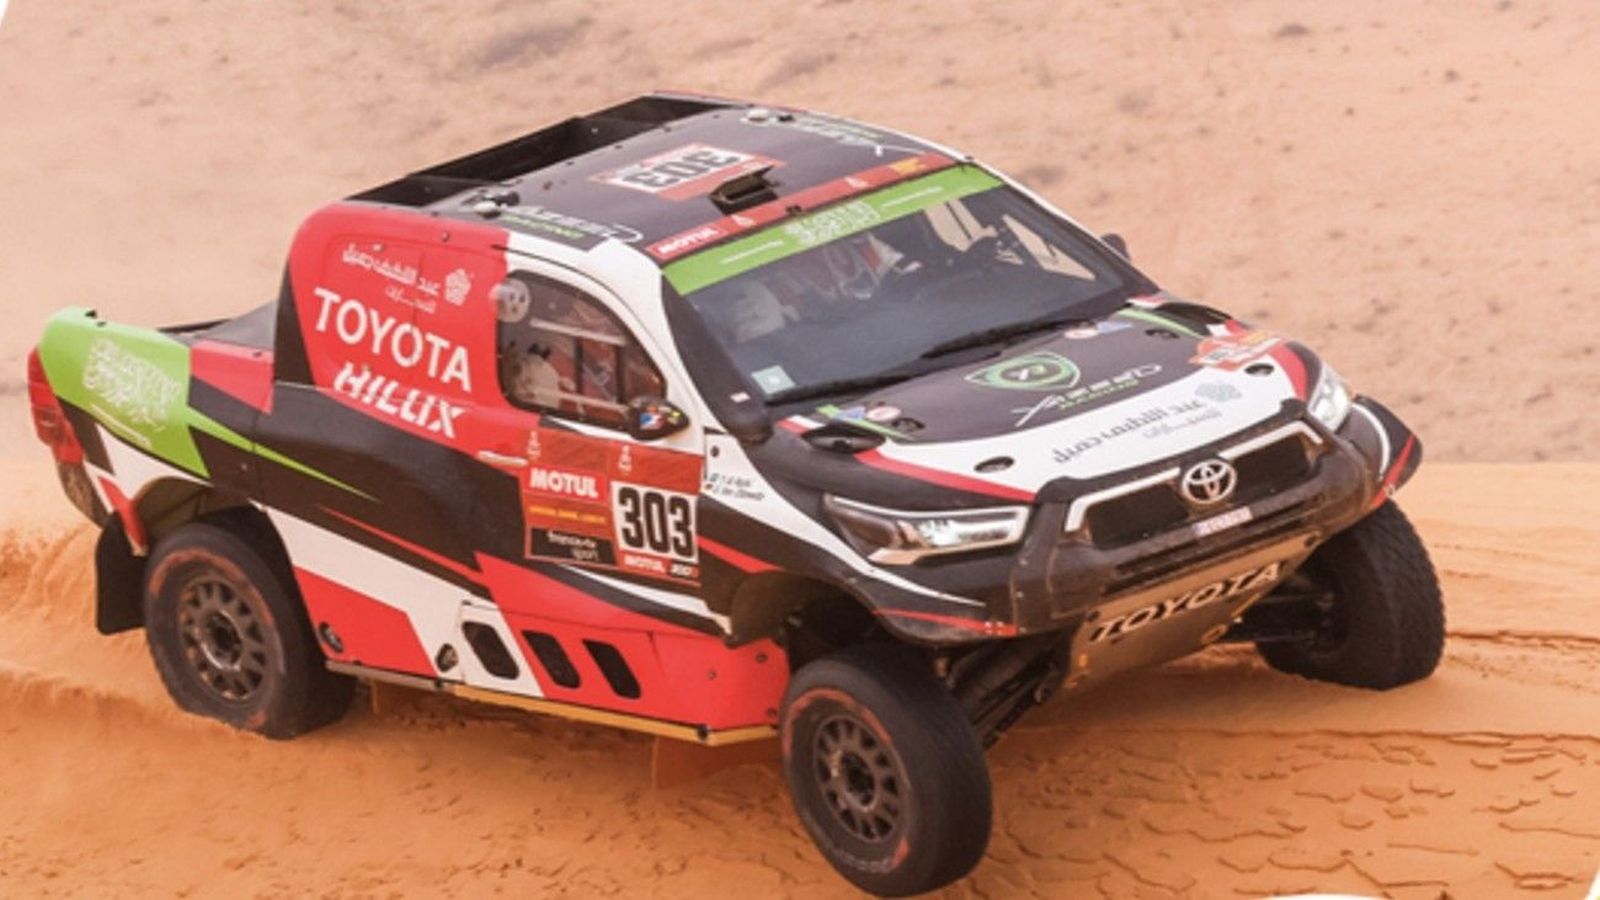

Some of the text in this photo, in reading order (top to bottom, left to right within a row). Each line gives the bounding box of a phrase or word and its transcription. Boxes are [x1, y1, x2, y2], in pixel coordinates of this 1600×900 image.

[314, 287, 472, 392] TOYOTA
[333, 362, 465, 439] HILUX
[530, 469, 598, 498] MOTUL
[618, 486, 693, 557] 303
[1089, 563, 1281, 642] TOYOTA
